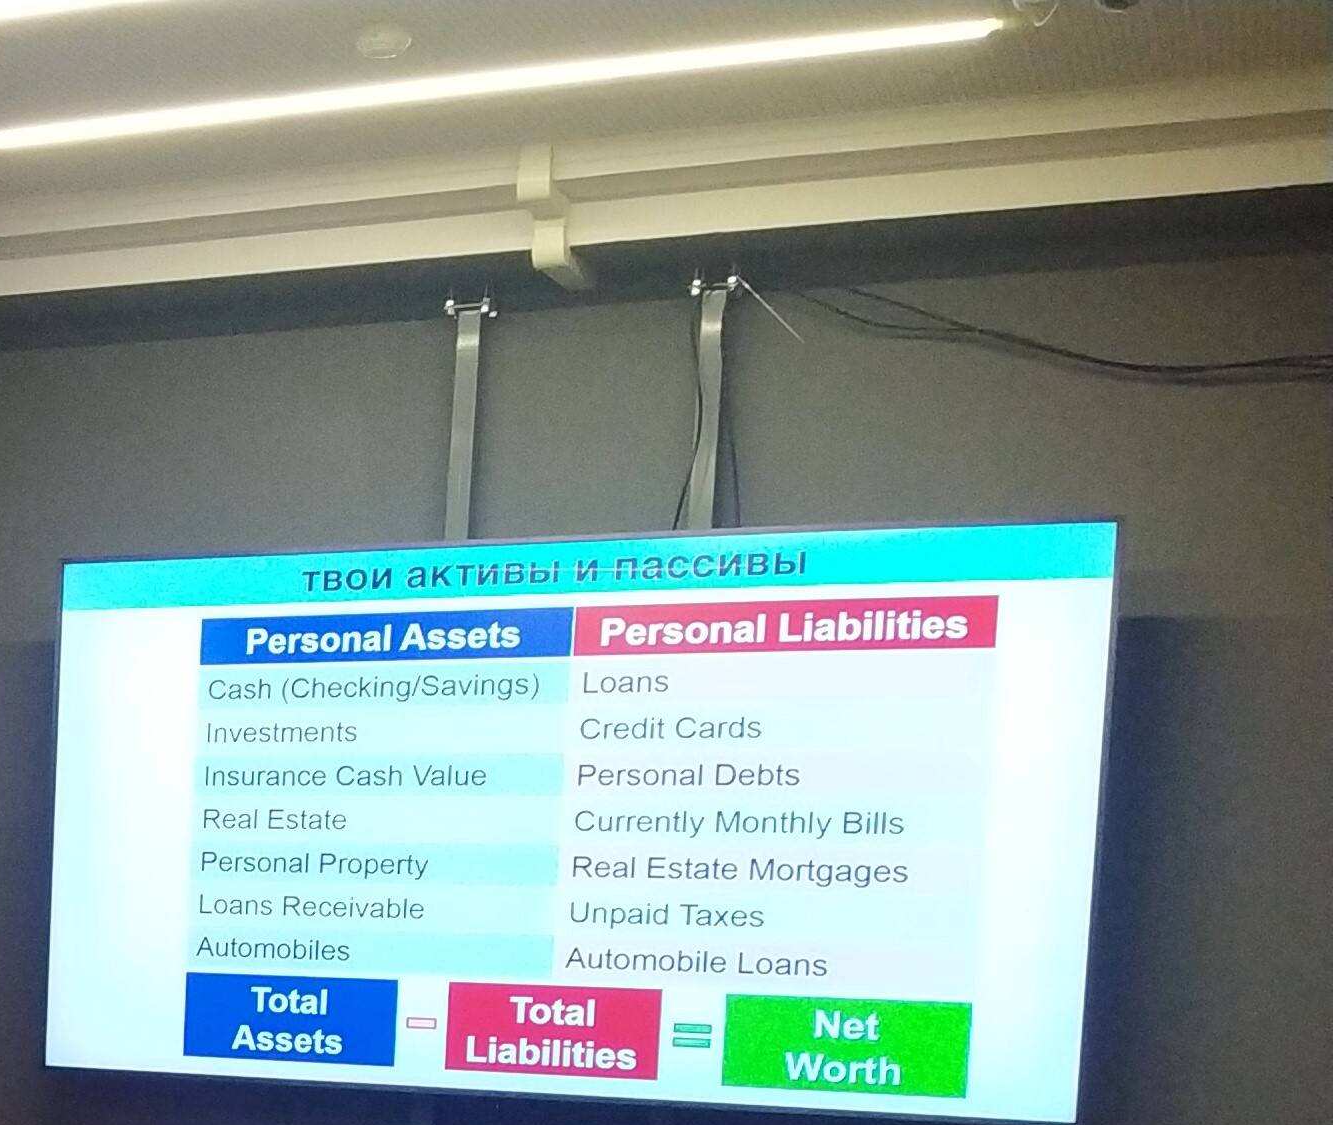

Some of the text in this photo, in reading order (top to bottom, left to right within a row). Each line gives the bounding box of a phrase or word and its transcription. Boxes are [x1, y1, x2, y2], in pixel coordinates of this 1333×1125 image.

[301, 550, 807, 592] твои активы и пассивы
[245, 621, 521, 655] Personal Assets
[600, 609, 968, 647] Personal Liabilities
[208, 673, 540, 705] Cash (Checking/Savings)
[583, 671, 669, 694] Loans
[207, 721, 358, 743] Investments
[580, 716, 762, 740] Credit Cards
[205, 764, 487, 787] Insurance Cash Value
[577, 763, 800, 787] Personal Debts
[203, 808, 347, 831] Real Estate
[574, 810, 905, 840] Currently Monthly Bills
[201, 851, 429, 881] Personal Property
[572, 855, 909, 889] Real Estate Mortgages
[199, 893, 425, 920] Loans Receivable
[570, 901, 765, 930] Unpaid Taxes
[196, 936, 350, 962] Automobiles
[565, 947, 828, 977] Automobile Loans
[250, 986, 328, 1016] Total
[509, 995, 596, 1027] Total
[231, 1024, 343, 1055] Assets
[813, 1008, 880, 1041] Net
[466, 1035, 637, 1071] Liabilities
[784, 1051, 901, 1086] Worth
